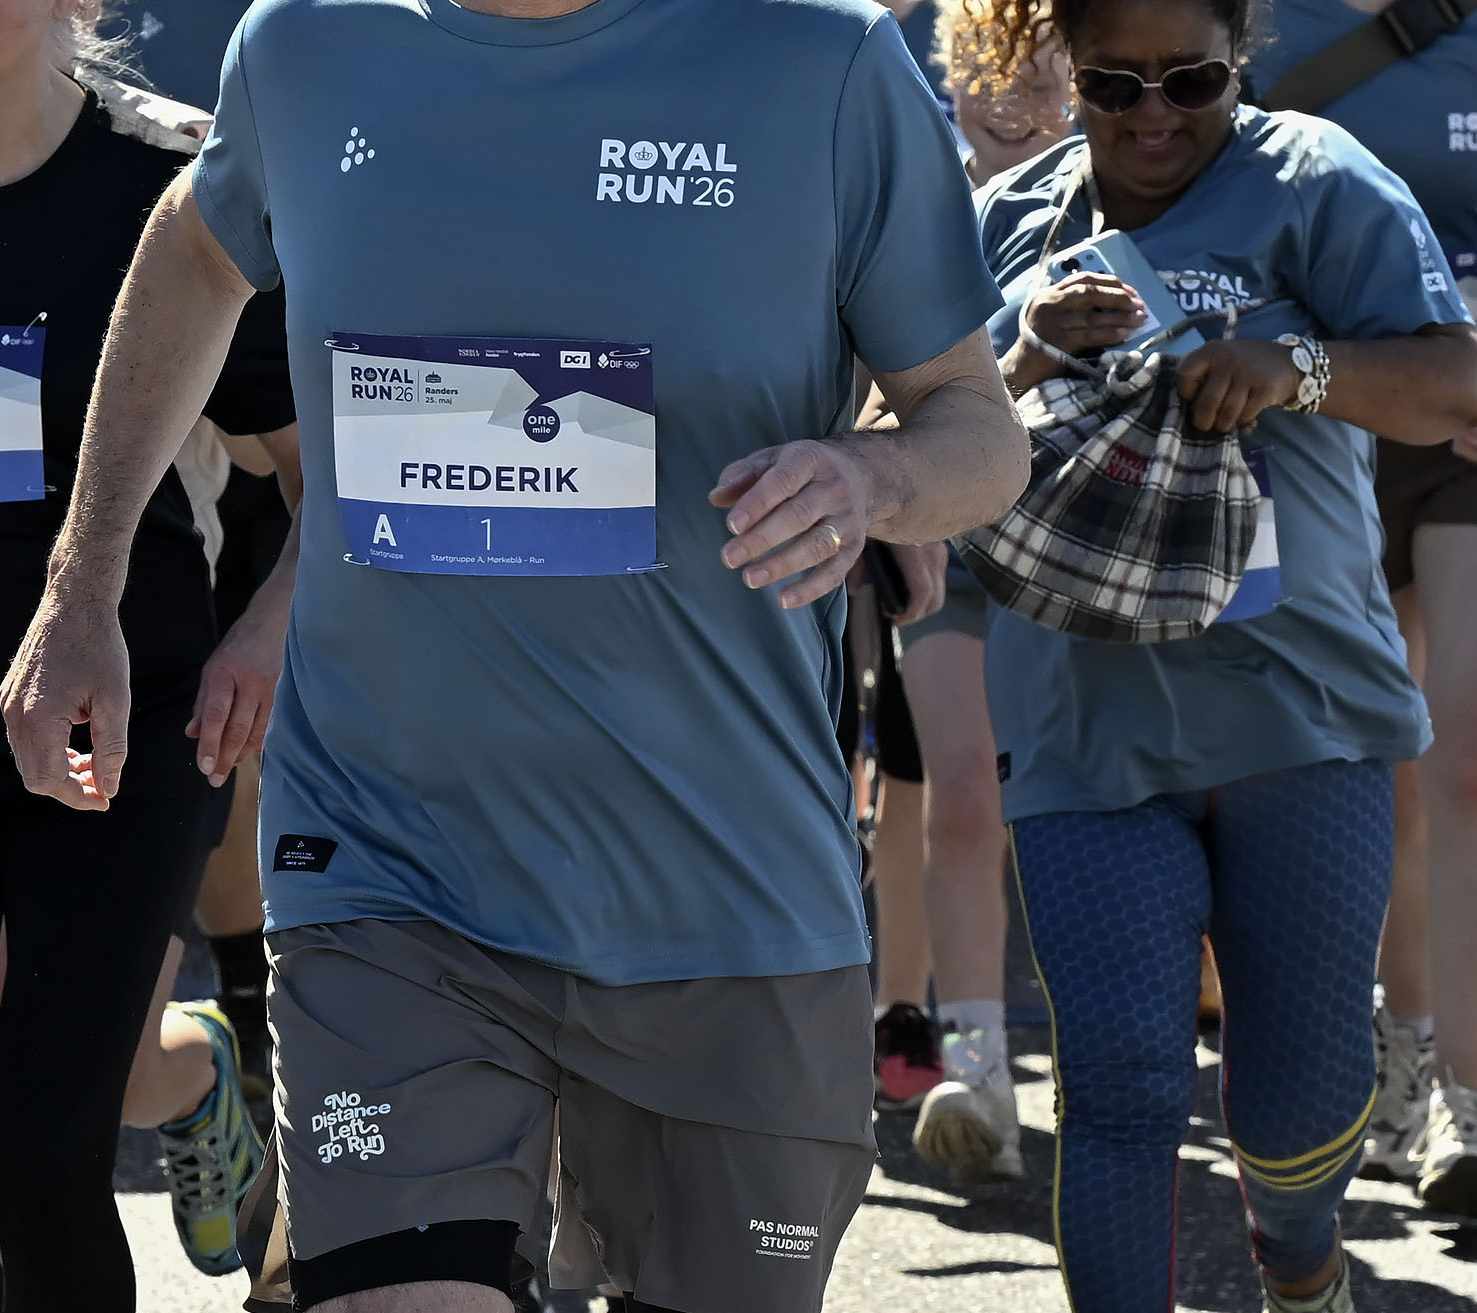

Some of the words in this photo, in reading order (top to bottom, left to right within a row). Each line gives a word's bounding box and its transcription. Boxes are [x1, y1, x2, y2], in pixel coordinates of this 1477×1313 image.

[599, 137, 738, 173] ROYAL
[563, 353, 588, 366] DGI
[350, 366, 414, 385] ROYAL
[425, 387, 459, 396] Randers
[425, 396, 436, 404] 25.
[438, 397, 453, 405] maj
[527, 414, 556, 426] one
[532, 426, 551, 435] mile
[400, 462, 580, 494] FREDERIK
[372, 513, 398, 547] A
[480, 518, 492, 551] 1
[369, 549, 404, 561] Startgruppe
[430, 555, 475, 566] Startgruppe
[487, 555, 522, 565] Mørkeblå
[529, 557, 545, 565] Run
[324, 1090, 362, 1110] No
[311, 1103, 392, 1133] Distance
[328, 1118, 380, 1142] Left
[317, 1141, 343, 1164] To
[346, 1134, 386, 1161] Run
[749, 1219, 774, 1234] PAS
[776, 1223, 819, 1238] NORMAL
